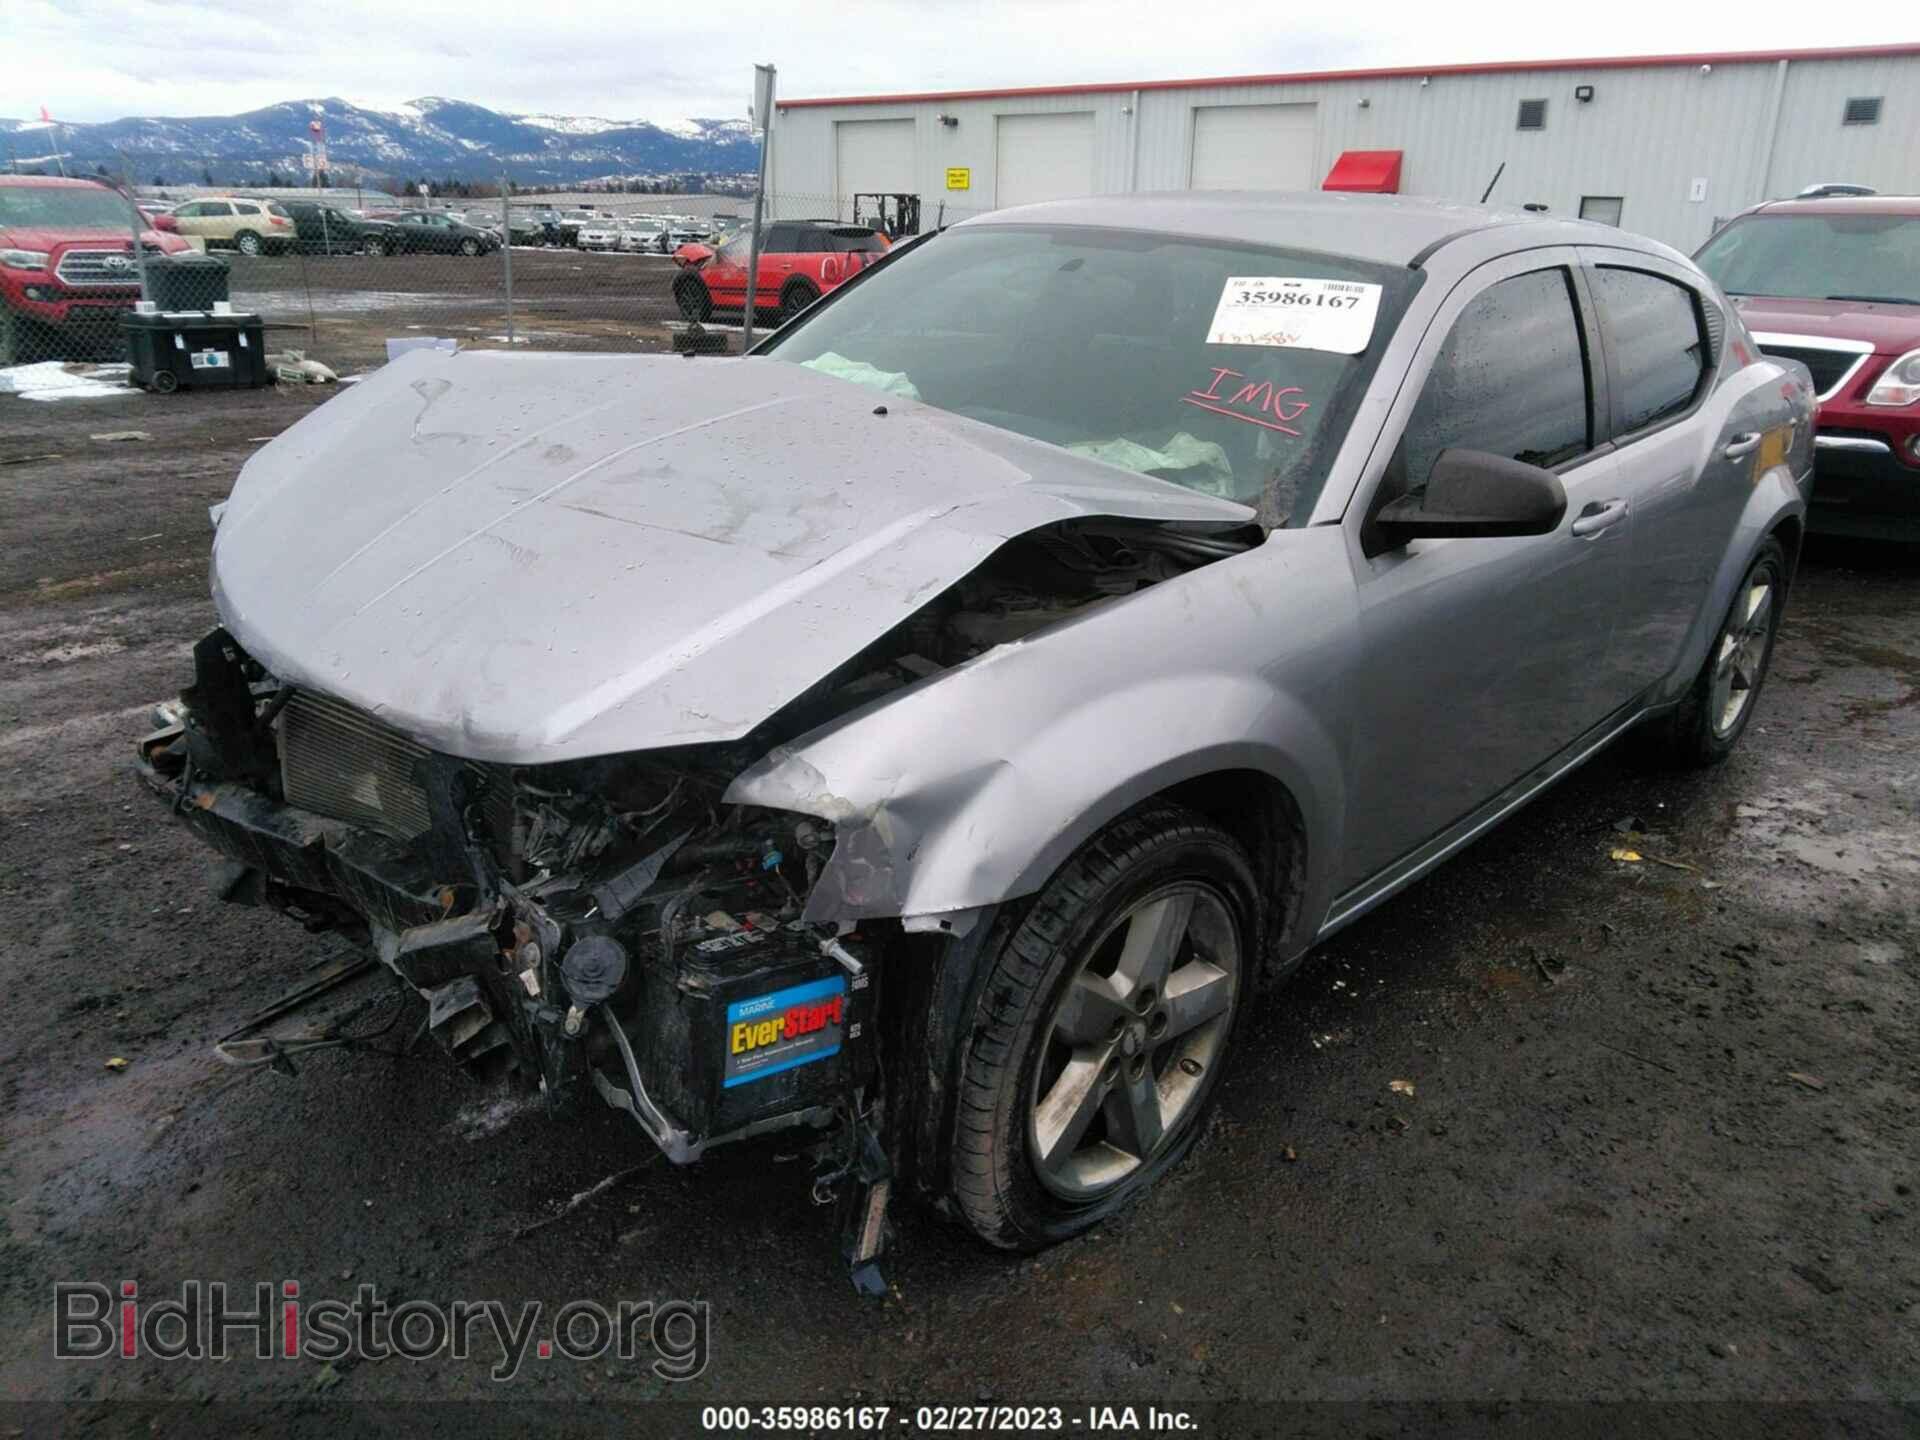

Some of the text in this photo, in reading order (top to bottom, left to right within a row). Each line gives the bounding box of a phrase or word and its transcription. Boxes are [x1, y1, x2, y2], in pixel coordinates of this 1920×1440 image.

[1235, 290, 1360, 310] 35986167
[1191, 367, 1311, 421] IMG
[731, 994, 843, 1055] EverStart
